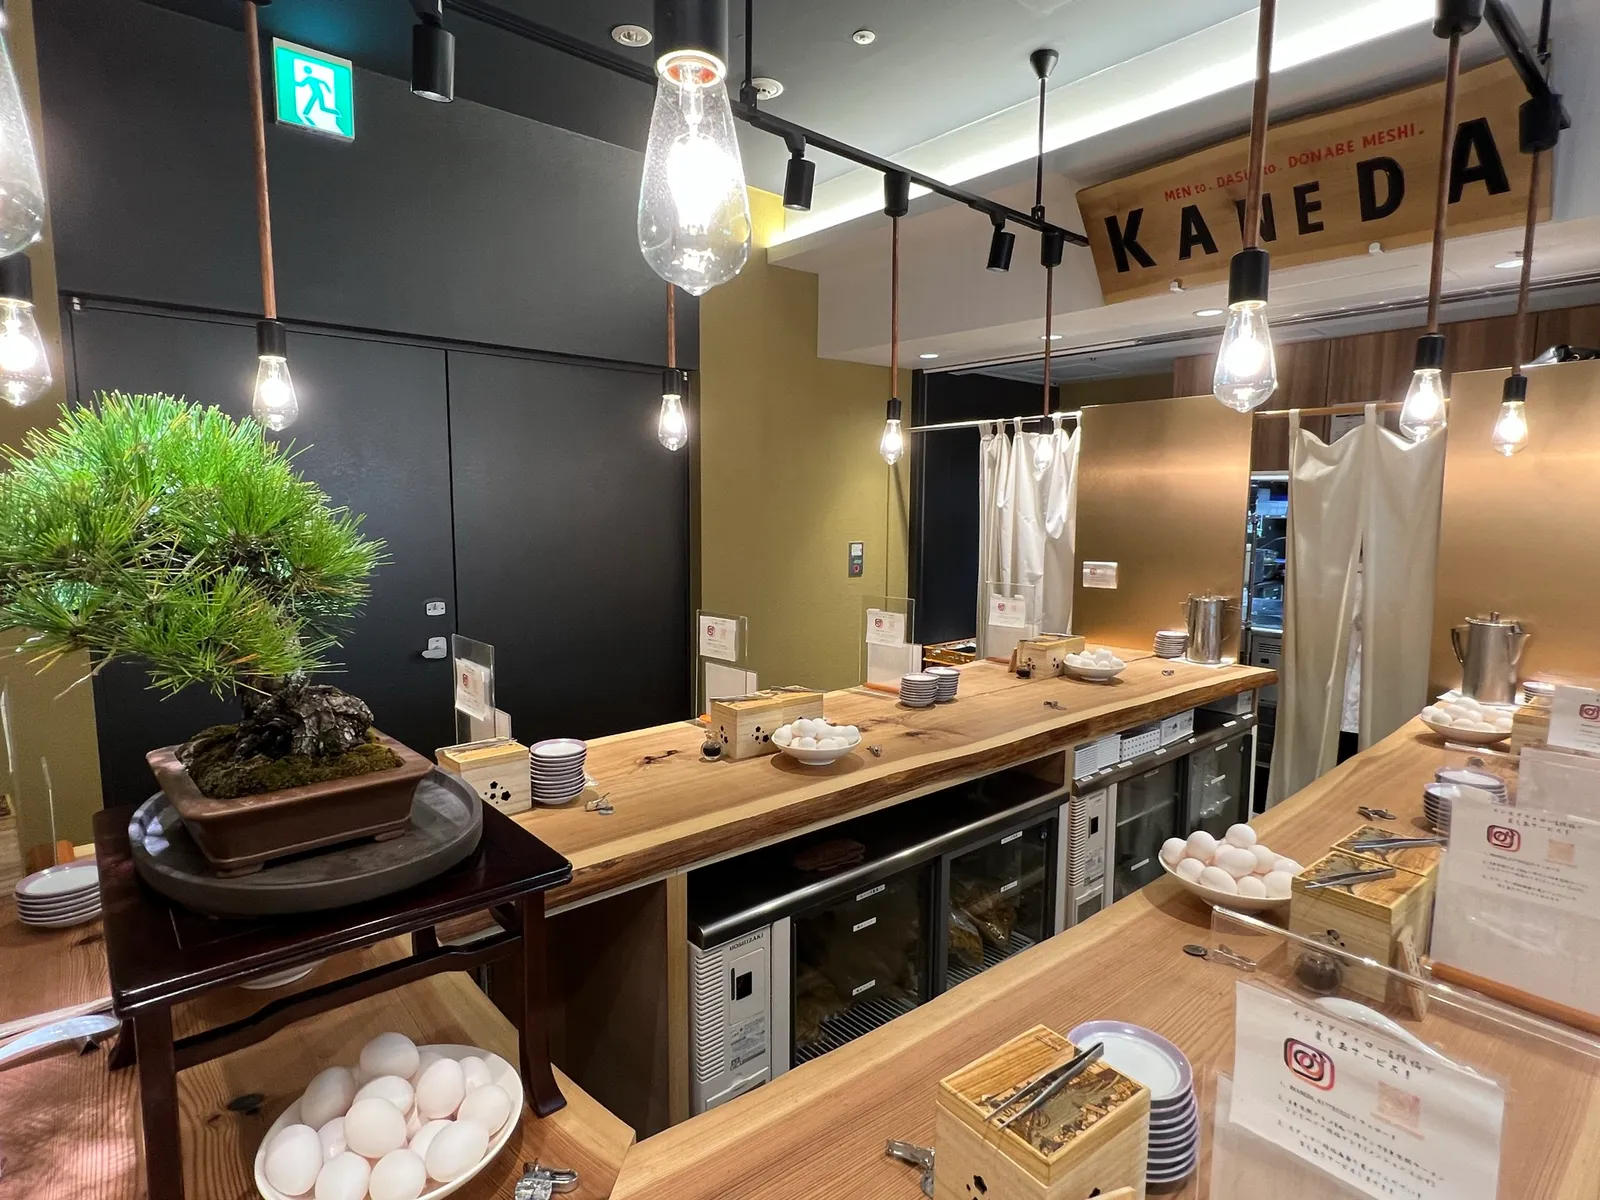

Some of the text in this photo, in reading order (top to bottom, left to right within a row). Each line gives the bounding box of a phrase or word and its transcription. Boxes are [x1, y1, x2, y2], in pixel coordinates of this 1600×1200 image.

[1104, 116, 1511, 272] KANEDA
[1165, 185, 1192, 202] MEN
[1216, 170, 1250, 188] DAS
[1288, 140, 1355, 169] DONABE
[1362, 122, 1424, 149] MESHI.
[730, 932, 764, 951] HOSHIZAKI
